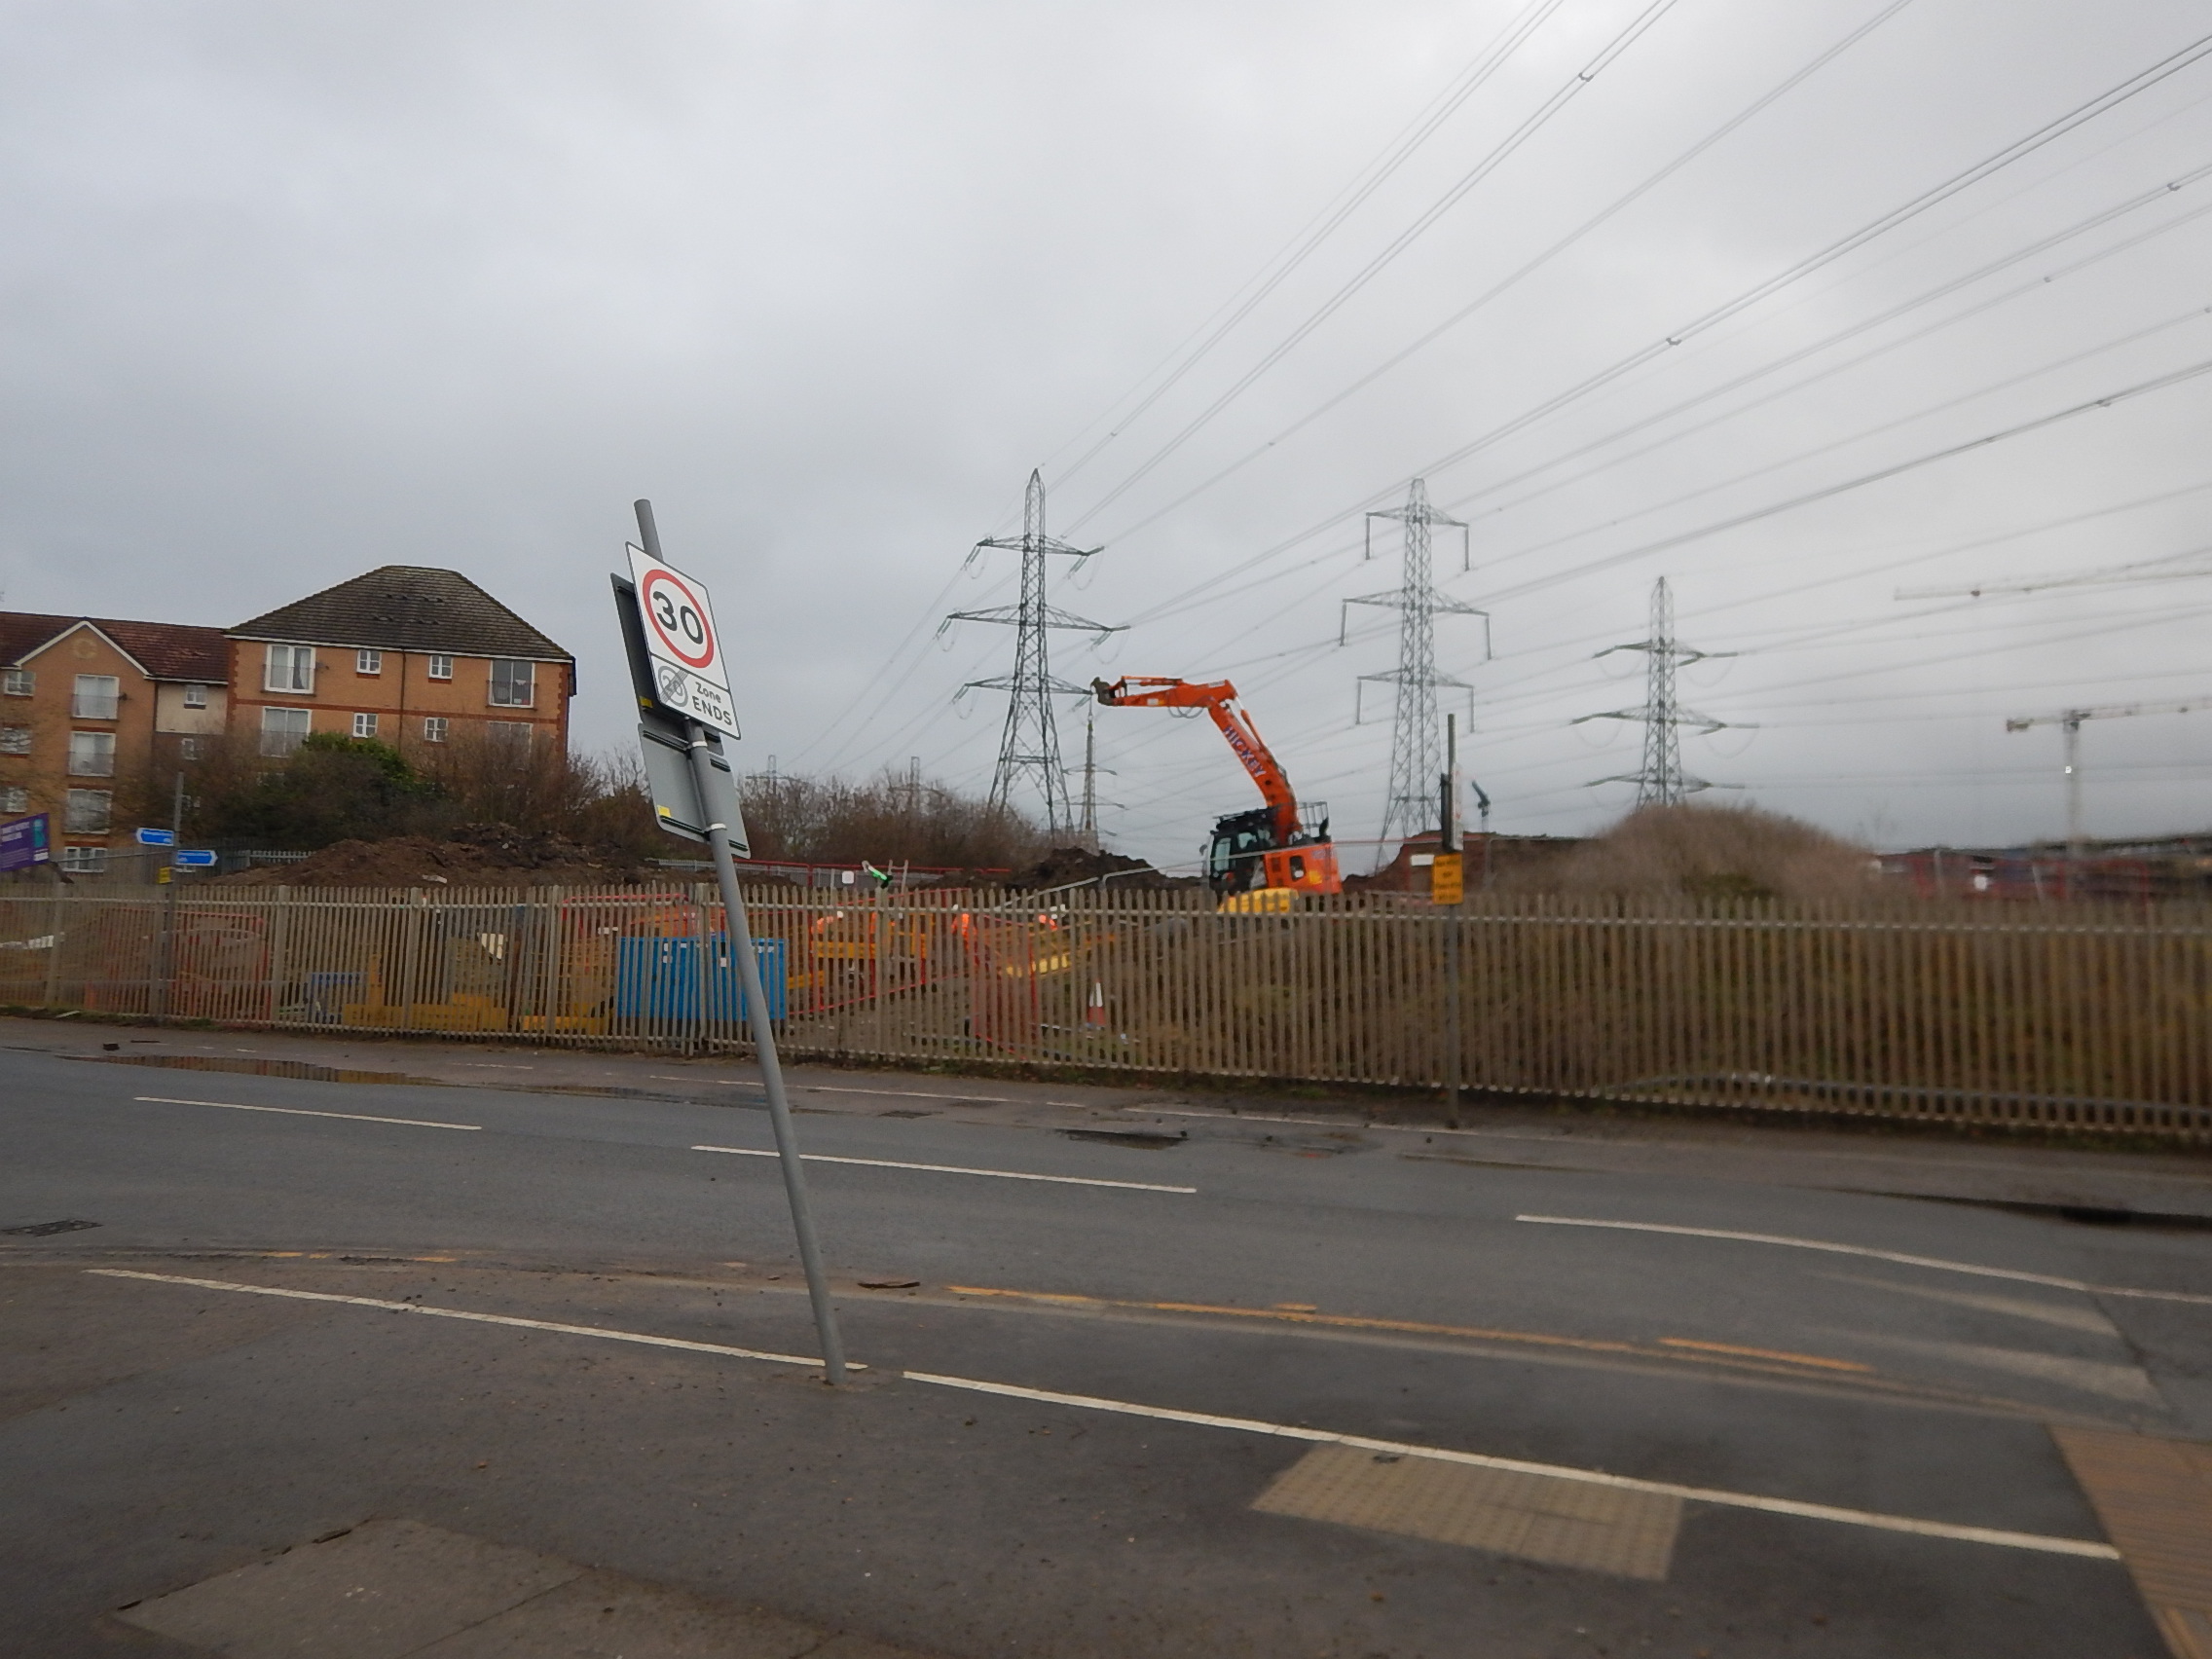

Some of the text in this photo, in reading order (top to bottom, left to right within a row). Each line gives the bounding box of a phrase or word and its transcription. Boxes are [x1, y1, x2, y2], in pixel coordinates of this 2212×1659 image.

[653, 591, 703, 645] 30
[663, 675, 683, 696] 20
[695, 682, 722, 703] Zone
[692, 695, 732, 725] ENDS
